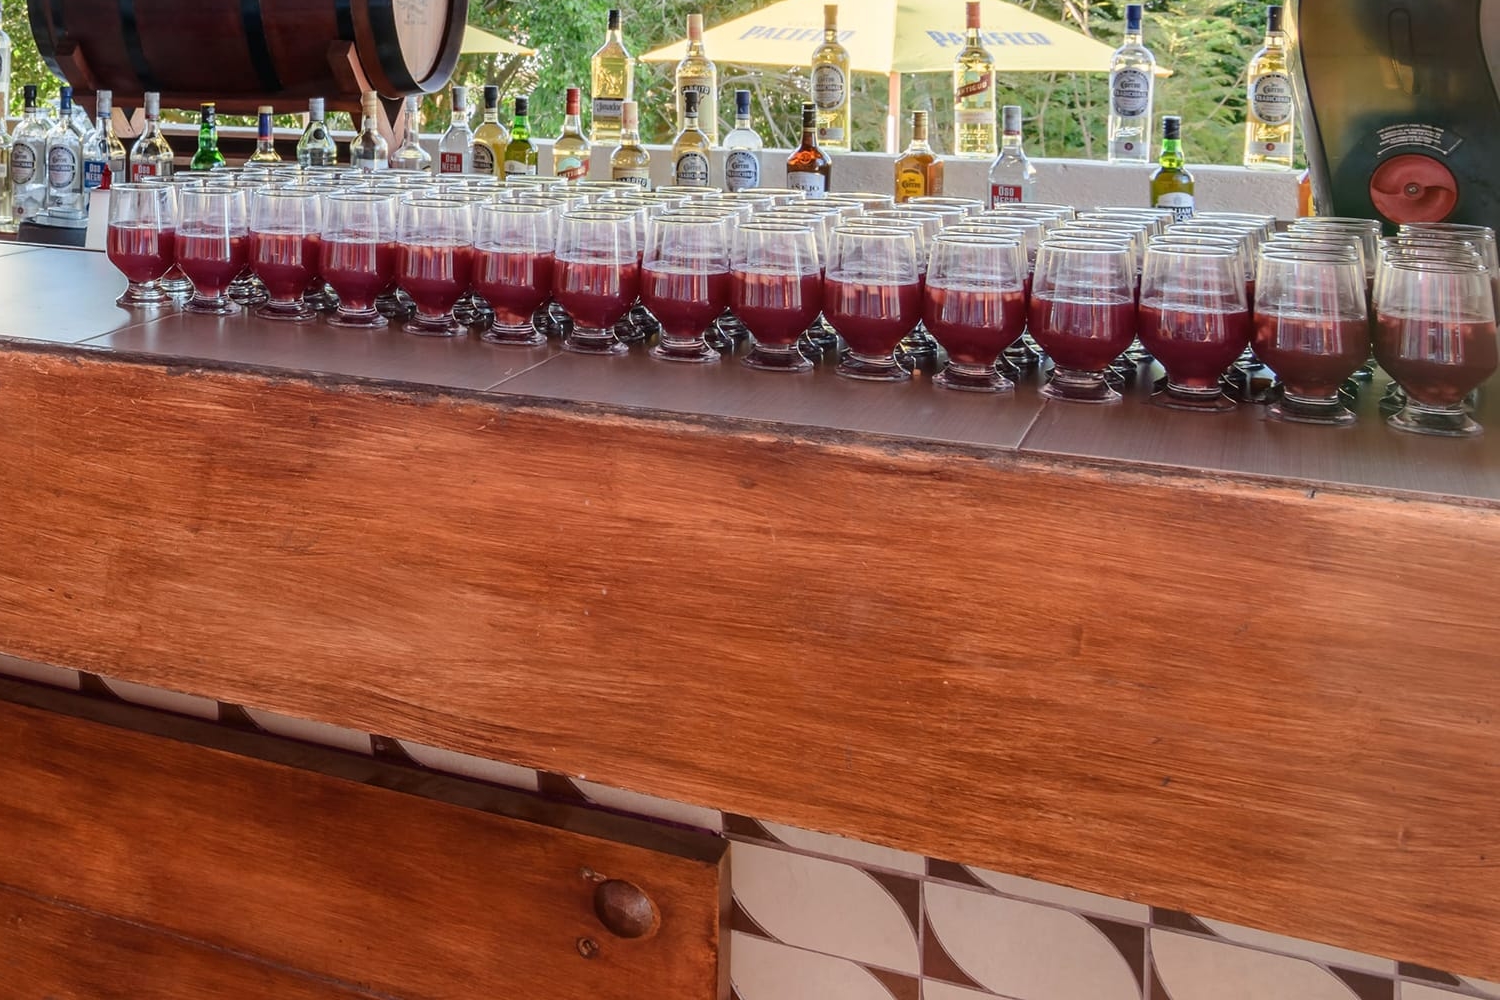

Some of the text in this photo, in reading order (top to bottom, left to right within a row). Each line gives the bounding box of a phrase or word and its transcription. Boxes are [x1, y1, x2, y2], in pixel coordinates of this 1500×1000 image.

[739, 25, 856, 41] PACIFIO
[925, 30, 1052, 47] PAIFICO
[85, 172, 102, 181] NEGR
